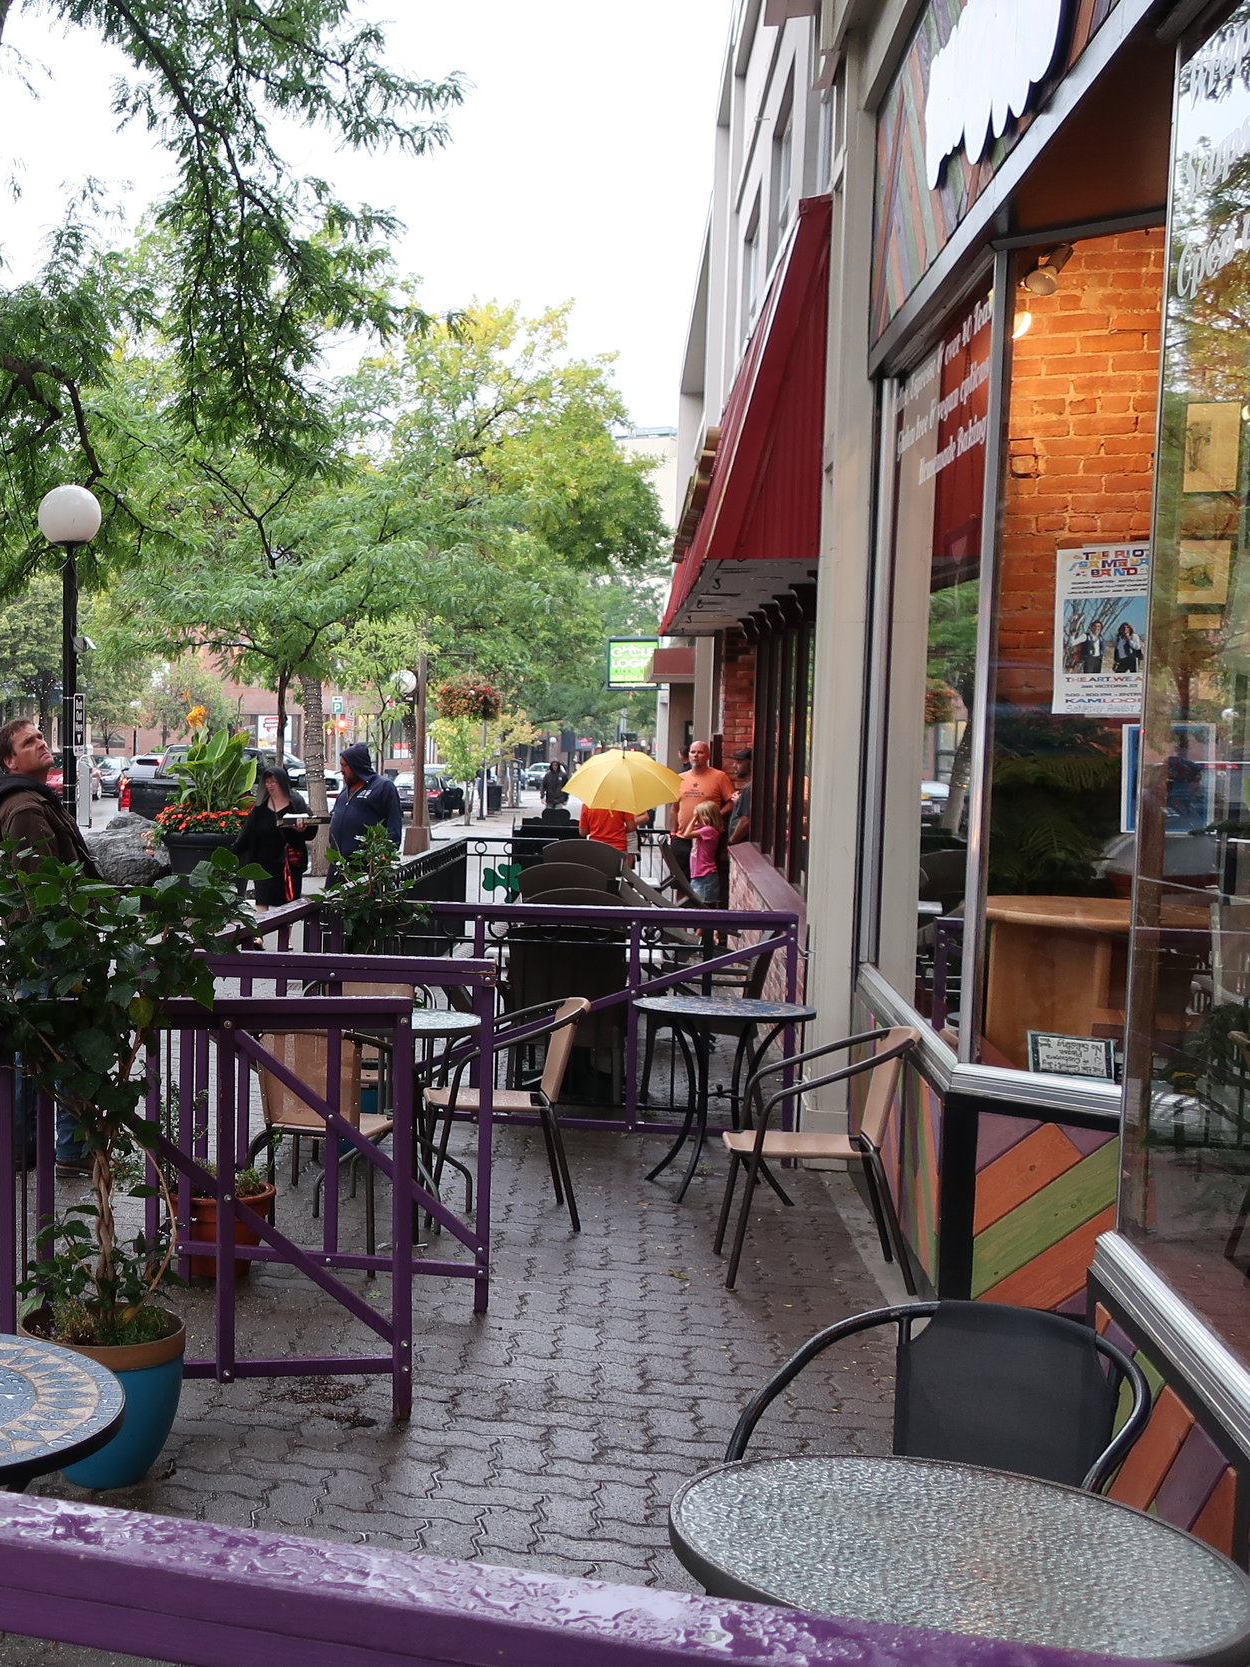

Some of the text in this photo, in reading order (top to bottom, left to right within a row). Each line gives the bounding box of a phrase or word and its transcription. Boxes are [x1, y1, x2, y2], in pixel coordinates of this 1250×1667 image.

[1177, 229, 1236, 299] Open
[1083, 550, 1110, 560] THE
[1090, 567, 1138, 578] BAND
